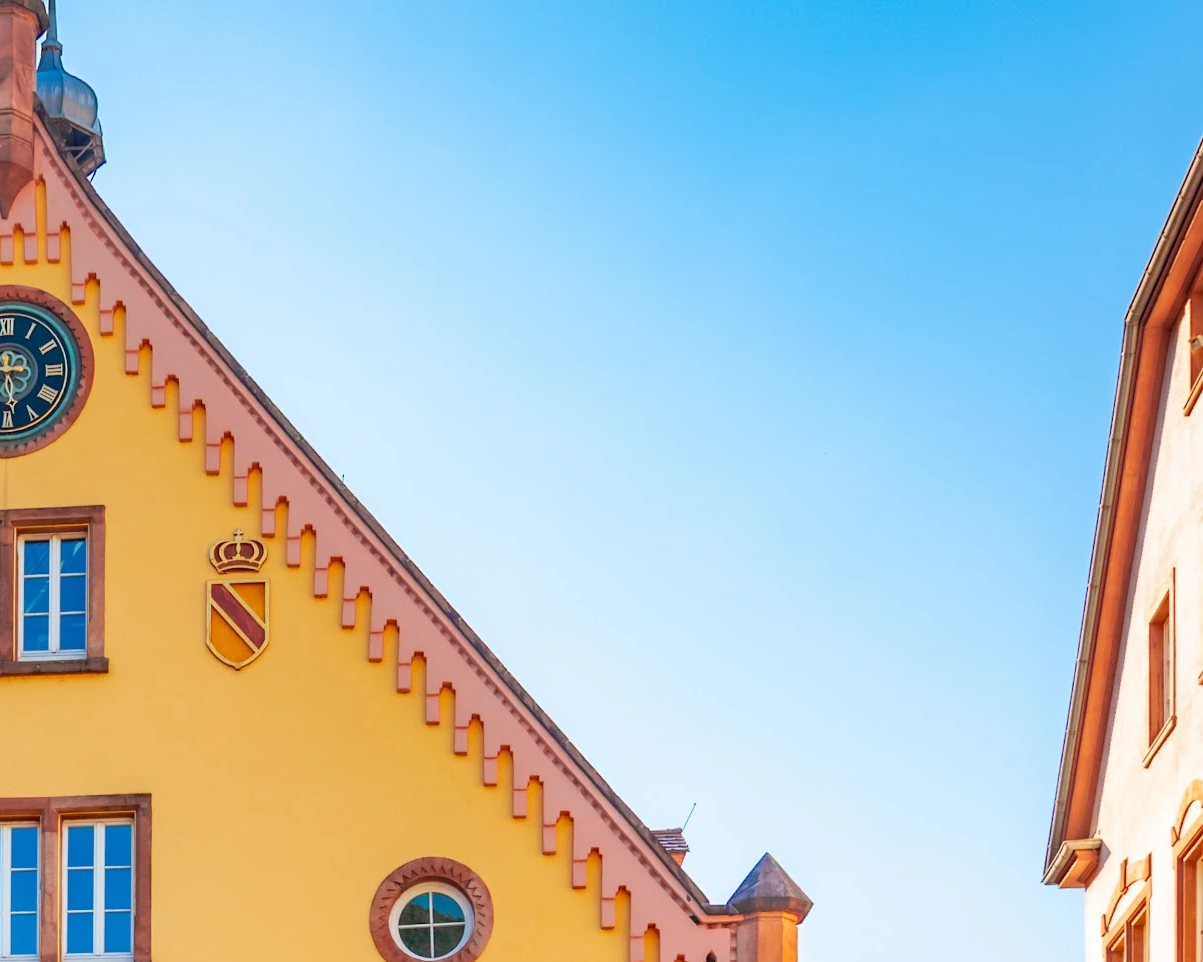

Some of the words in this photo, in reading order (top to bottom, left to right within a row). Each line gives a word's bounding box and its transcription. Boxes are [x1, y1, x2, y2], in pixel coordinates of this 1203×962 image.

[0, 318, 15, 336] XII
[25, 322, 37, 340] I
[38, 339, 57, 355] II
[45, 363, 63, 377] III
[37, 384, 58, 404] IIII
[2, 411, 13, 428] VI
[26, 405, 39, 421] V
